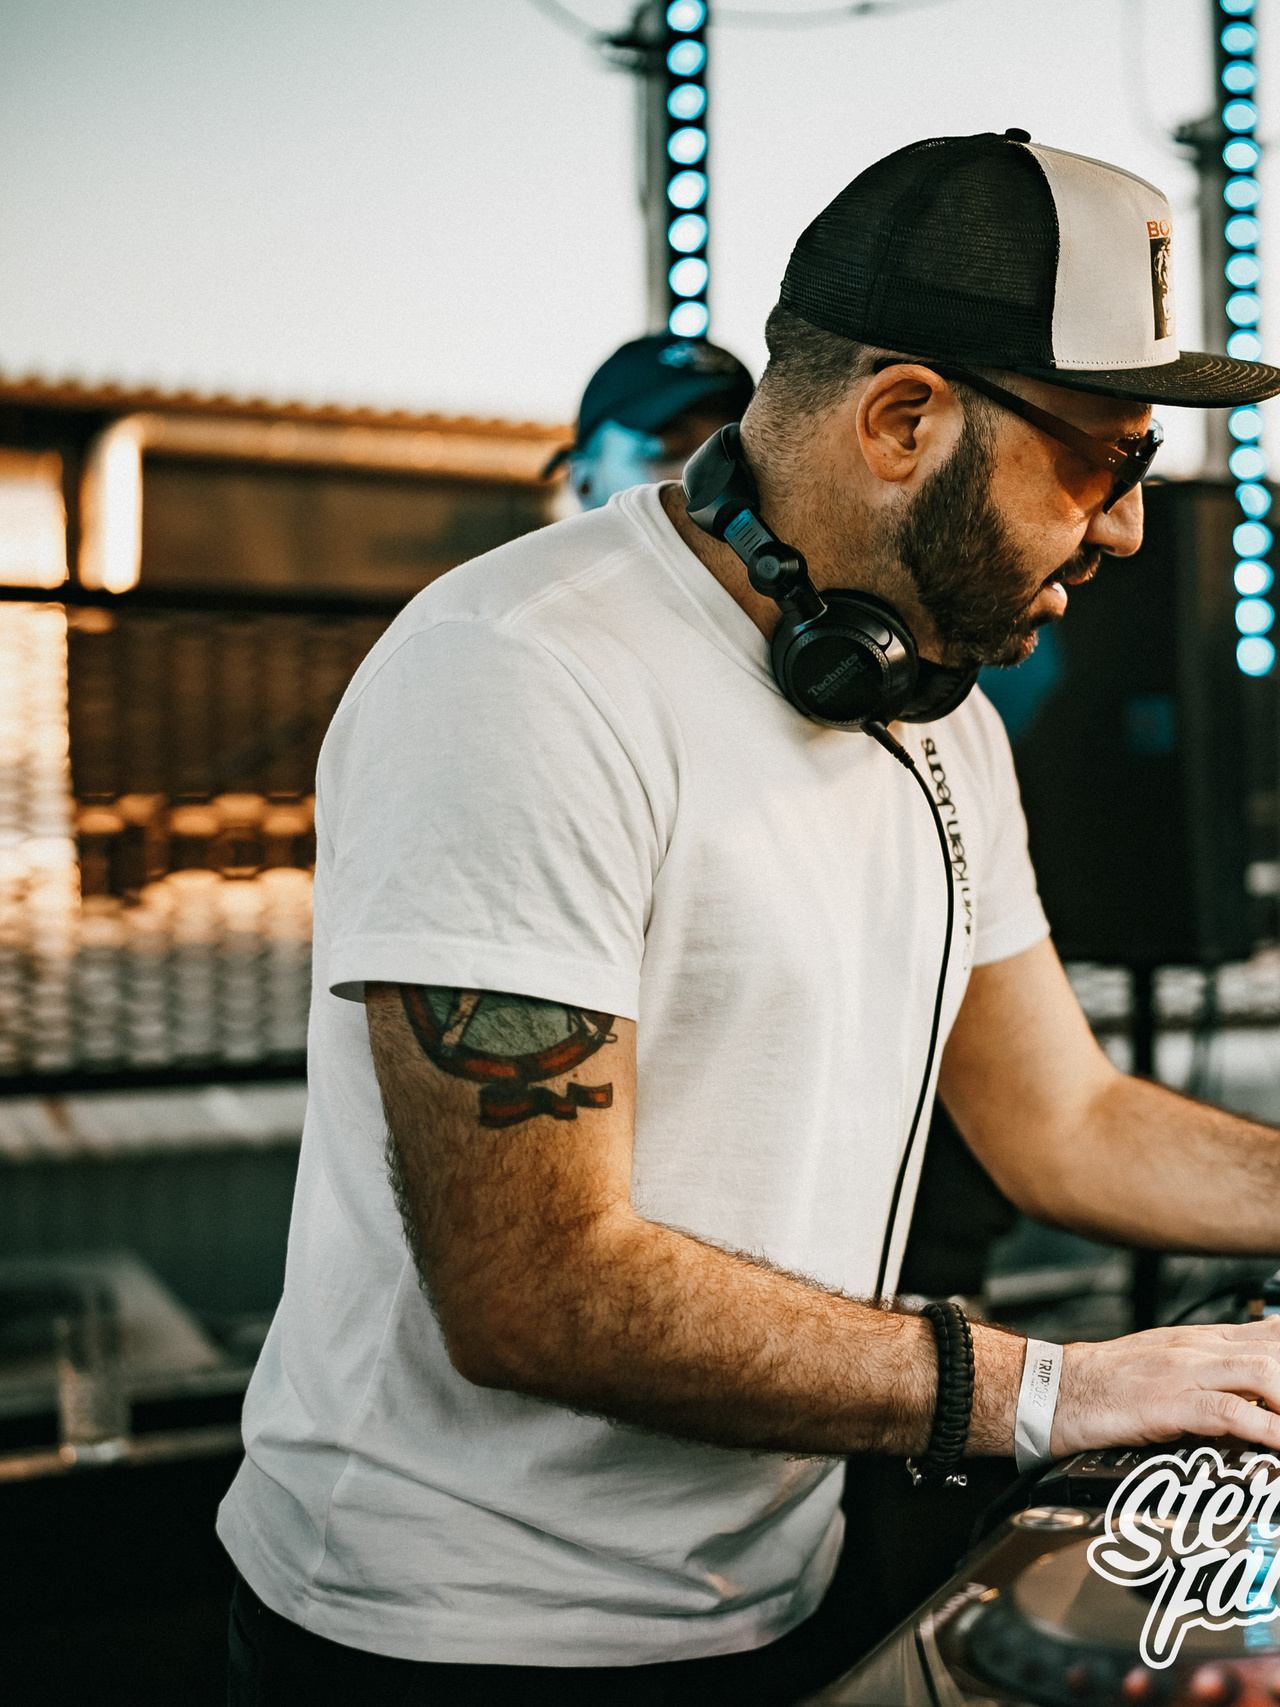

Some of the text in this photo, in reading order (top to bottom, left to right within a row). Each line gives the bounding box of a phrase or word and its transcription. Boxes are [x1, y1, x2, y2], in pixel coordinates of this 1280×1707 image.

[1146, 219, 1172, 237] BO
[807, 653, 859, 697] Technics
[817, 661, 869, 704] Technics
[921, 738, 956, 815] Jeans
[946, 820, 969, 881] Klein
[1038, 1359, 1053, 1384] TRIP
